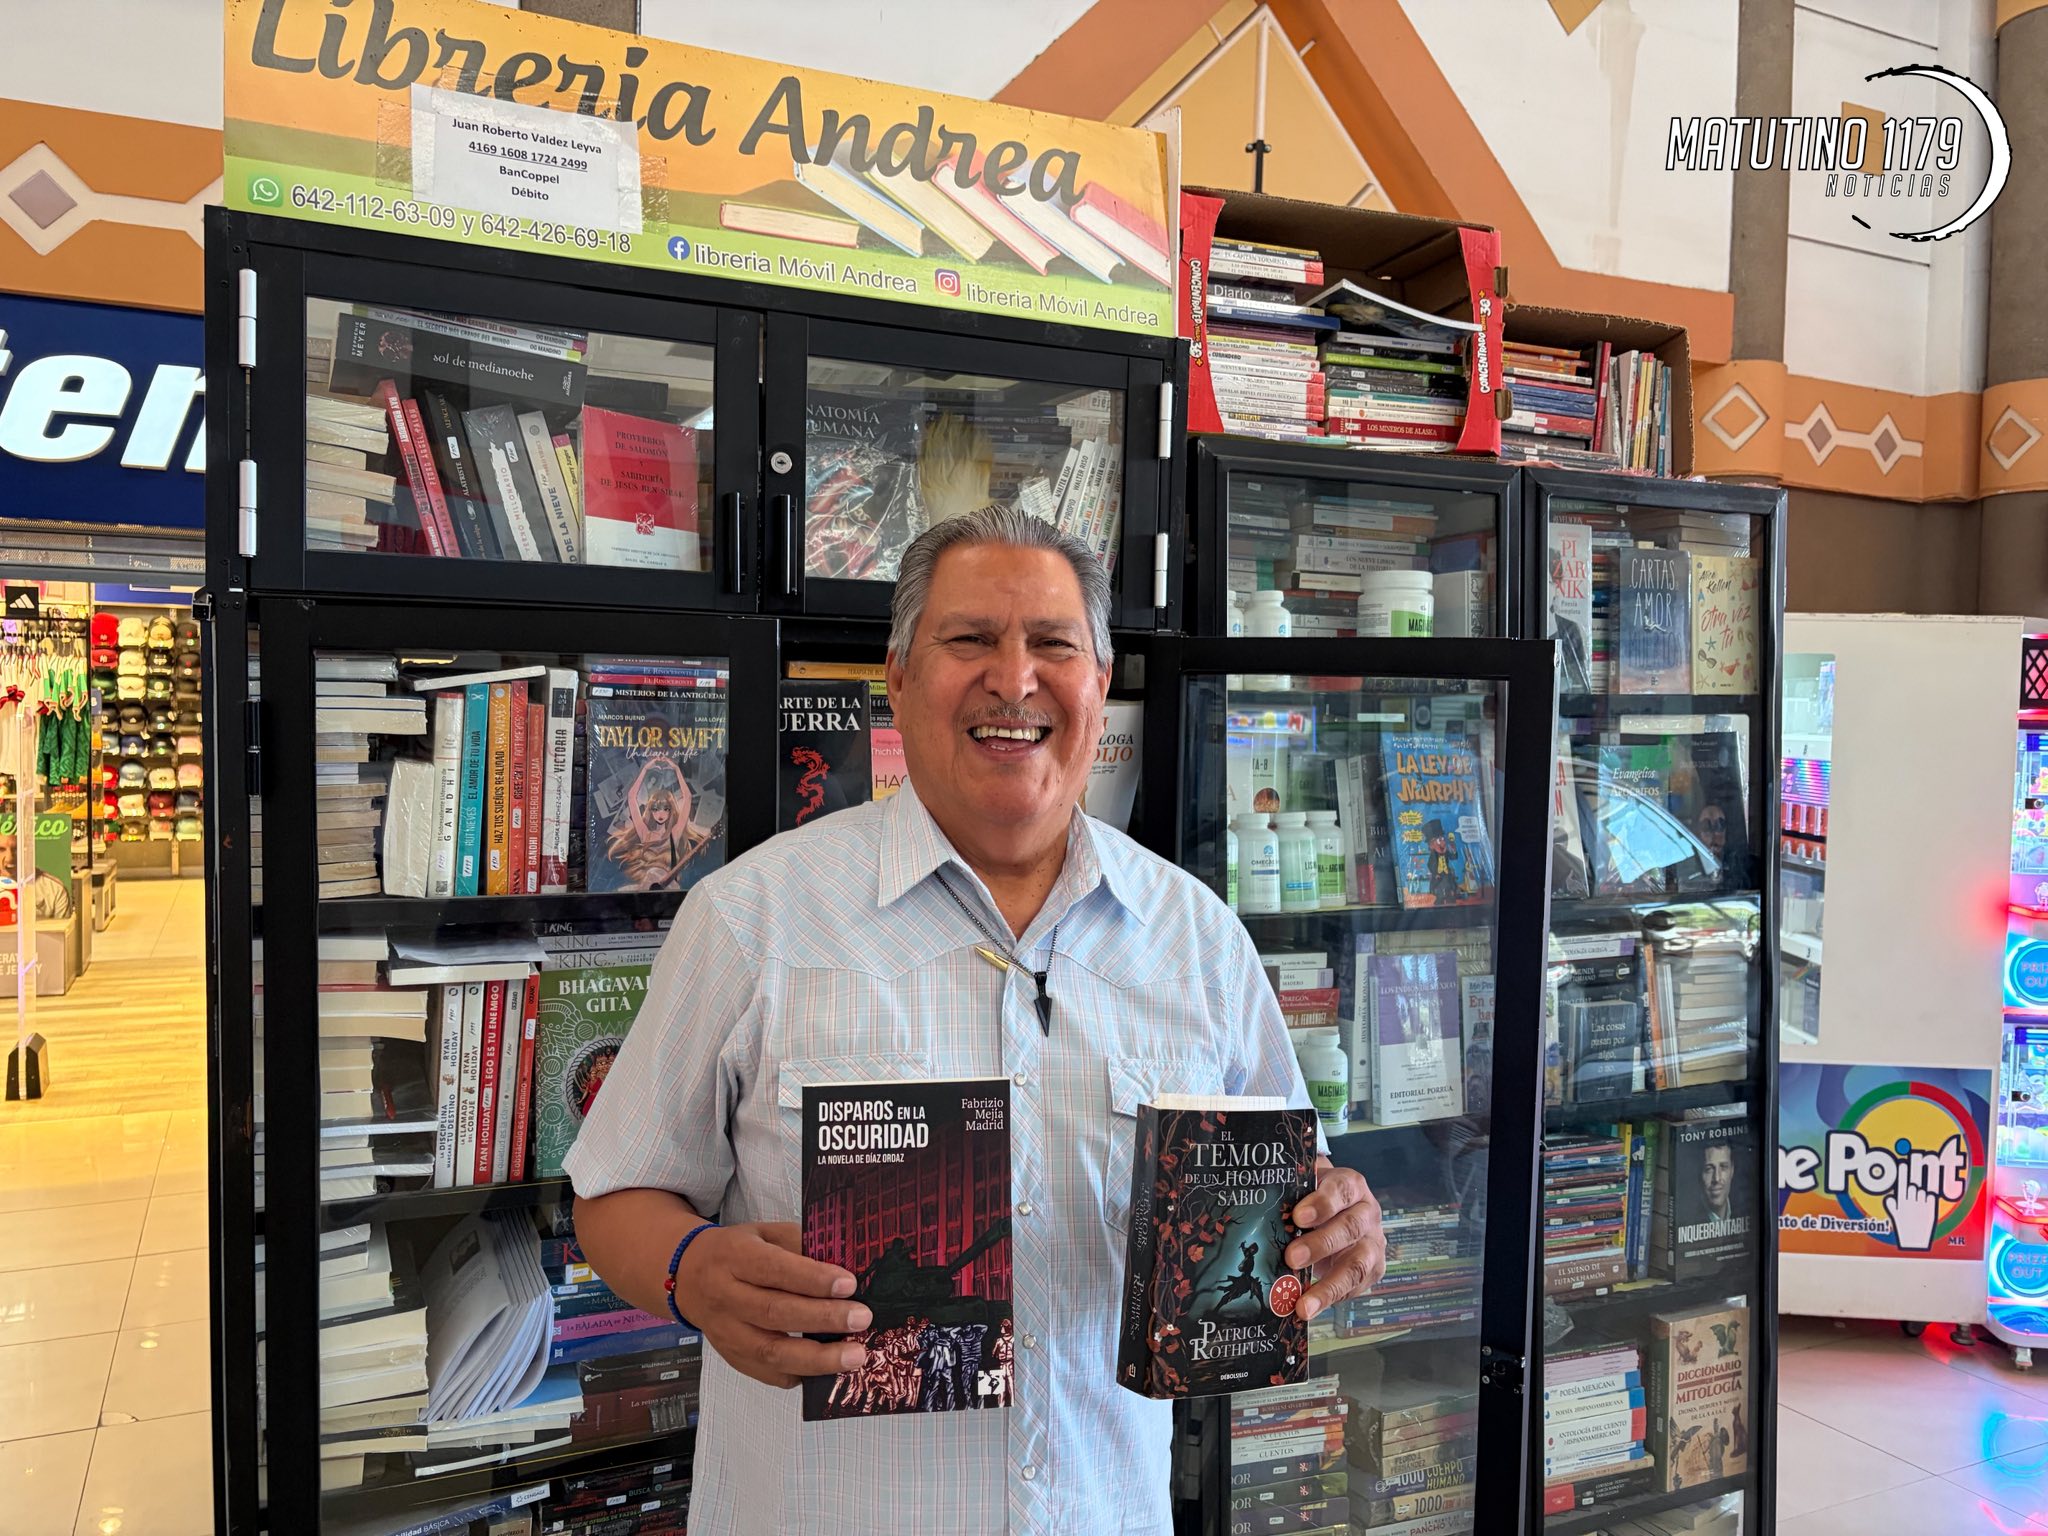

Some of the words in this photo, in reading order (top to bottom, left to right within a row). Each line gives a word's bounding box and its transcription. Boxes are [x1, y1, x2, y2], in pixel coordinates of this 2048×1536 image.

[452, 118, 479, 132] Juan
[482, 123, 529, 141] Roberto
[531, 133, 569, 148] Valdez
[571, 140, 602, 155] Leyva
[738, 76, 1089, 202] Andrea
[468, 141, 498, 154] 4169
[500, 147, 528, 160] 1608
[531, 152, 558, 165] 1724
[560, 157, 588, 170] 2499
[499, 165, 560, 184] BanCoppel
[511, 186, 549, 201] Débito
[291, 185, 456, 229] 642-112-63-09
[462, 213, 474, 237] y
[480, 215, 631, 254] 642-426-69-18
[695, 243, 772, 275] libreria
[779, 254, 835, 282] Móvil
[841, 265, 918, 294] Andrea
[1214, 284, 1252, 300] Diario
[966, 282, 1032, 310] libreria
[1039, 290, 1088, 318] Móvil
[1094, 301, 1160, 329] Andrea
[358, 322, 367, 358] MEYER
[433, 353, 450, 364] sol
[452, 356, 466, 368] de
[468, 359, 534, 382] medianoche
[1478, 332, 1490, 394] CONCENTRADO
[616, 431, 666, 447] PROVERBIOS
[1379, 424, 1405, 434] MINEROS
[1405, 426, 1414, 435] DE
[1414, 427, 1437, 436] ALASKA
[615, 441, 626, 450] DE
[456, 461, 470, 497] ALATRISTE
[600, 477, 611, 487] DE
[641, 486, 658, 494] BEN
[1073, 469, 1085, 491] WALTER
[500, 467, 520, 521] MILLONARIO
[548, 486, 565, 519] NIEVE
[558, 521, 569, 536] LA
[564, 540, 573, 551] DE
[1561, 539, 1577, 558] PI
[1552, 559, 1586, 580] ZAR
[1630, 558, 1676, 591] CARTAS
[1633, 592, 1672, 628] AMOR
[1701, 605, 1727, 632] Otra
[615, 688, 656, 698] MISTERIOS
[657, 690, 669, 698] DE
[817, 697, 838, 709] DE
[841, 698, 862, 709] LA
[471, 730, 481, 748] VIDA
[598, 725, 664, 748] TAYLOR
[668, 727, 727, 749] SWIFT
[471, 749, 480, 758] TU
[551, 729, 567, 773] VICTORIA
[470, 760, 480, 768] DE
[494, 751, 505, 785] REALIDAD
[531, 757, 540, 779] ALMA
[1397, 752, 1419, 775] LA
[1419, 754, 1448, 775] LEY
[1452, 754, 1472, 776] DE
[1612, 767, 1656, 782] Evangelios
[469, 769, 480, 789] AMOR
[530, 780, 539, 794] DEL
[1397, 777, 1475, 802] MURPHY
[468, 789, 478, 800] EL
[493, 786, 504, 813] SUEÑOS
[513, 780, 523, 800] CREE
[444, 768, 455, 841] GANDHI
[529, 795, 539, 833] GUERRERO
[464, 807, 477, 832] NIEVES
[495, 814, 504, 828] TUS
[463, 832, 476, 846] RUT
[494, 830, 504, 844] HAZ
[529, 836, 538, 866] GANDHI
[548, 922, 573, 934] KING
[554, 935, 597, 949] KING
[559, 952, 607, 969] KING
[488, 985, 500, 1030] ENEMIGO
[586, 991, 632, 1013] GITÁ
[487, 1032, 496, 1043] TU
[442, 1038, 450, 1061] RYAN
[450, 1031, 458, 1067] HOLIDAY
[486, 1046, 496, 1057] ES
[462, 1052, 470, 1074] RYAN
[470, 1045, 479, 1081] HOLIDAY
[485, 1060, 495, 1079] EGO
[518, 1082, 528, 1112] camino
[961, 1097, 1004, 1110] Fabrizio
[1390, 1089, 1426, 1100] EDITORIAL
[447, 1093, 455, 1129] DESTINO
[460, 1099, 468, 1138] LLAMADA
[467, 1100, 475, 1132] CORAJE
[818, 1100, 894, 1123] DISPAROS
[897, 1106, 912, 1120] EN
[912, 1106, 926, 1120] LA
[975, 1108, 1004, 1121] Mejía
[438, 1104, 448, 1151] DISCIPLINA
[481, 1106, 491, 1145] HOLIDAY
[965, 1119, 1004, 1131] Madrid
[447, 1131, 454, 1142] TU
[818, 1122, 930, 1151] OSCURIDAD
[1221, 1131, 1235, 1142] EL
[1680, 1131, 1706, 1143] TONY
[479, 1147, 489, 1172] RYAN
[514, 1130, 524, 1168] obstáculo
[817, 1156, 827, 1165] LA
[827, 1154, 854, 1165] NOVELA
[855, 1154, 865, 1164] DE
[865, 1153, 882, 1164] DÍAZ
[882, 1152, 905, 1163] ORDAZ
[1190, 1141, 1287, 1168] TEMOR
[1824, 1130, 1968, 1202] Point
[1184, 1173, 1201, 1185] DE
[1203, 1173, 1221, 1185] UN
[1224, 1167, 1296, 1188] HOMBRE
[1217, 1188, 1267, 1207] SABIO
[1640, 1179, 1653, 1217] AFTER
[1801, 1215, 1818, 1230] de
[1820, 1216, 1890, 1234] Diversión!
[1948, 1236, 1966, 1246] MR
[1554, 1271, 1607, 1286] TUTANKHAMÓN
[2011, 1266, 2043, 1279] OUT
[1275, 1279, 1298, 1295] BEST
[575, 1319, 613, 1332] BALADA
[1198, 1318, 1267, 1343] PATRICK
[1189, 1333, 1280, 1362] ROTHFUSS
[1677, 1359, 1742, 1382] DICCIONARIO
[1559, 1385, 1581, 1397] POESÍA
[1582, 1380, 1616, 1393] MEXICANA
[1675, 1372, 1743, 1405] MITOLOGÍA
[1558, 1426, 1592, 1439] ANTOLOGÍA
[1592, 1425, 1603, 1434] DEL
[1604, 1420, 1628, 1431] CUENTO
[1258, 1447, 1294, 1459] CUENTOS
[1426, 1460, 1463, 1478] CUERPO
[1426, 1473, 1465, 1490] HUMANO
[1414, 1494, 1442, 1516] 1000
[1409, 1522, 1446, 1536] PANCHO
